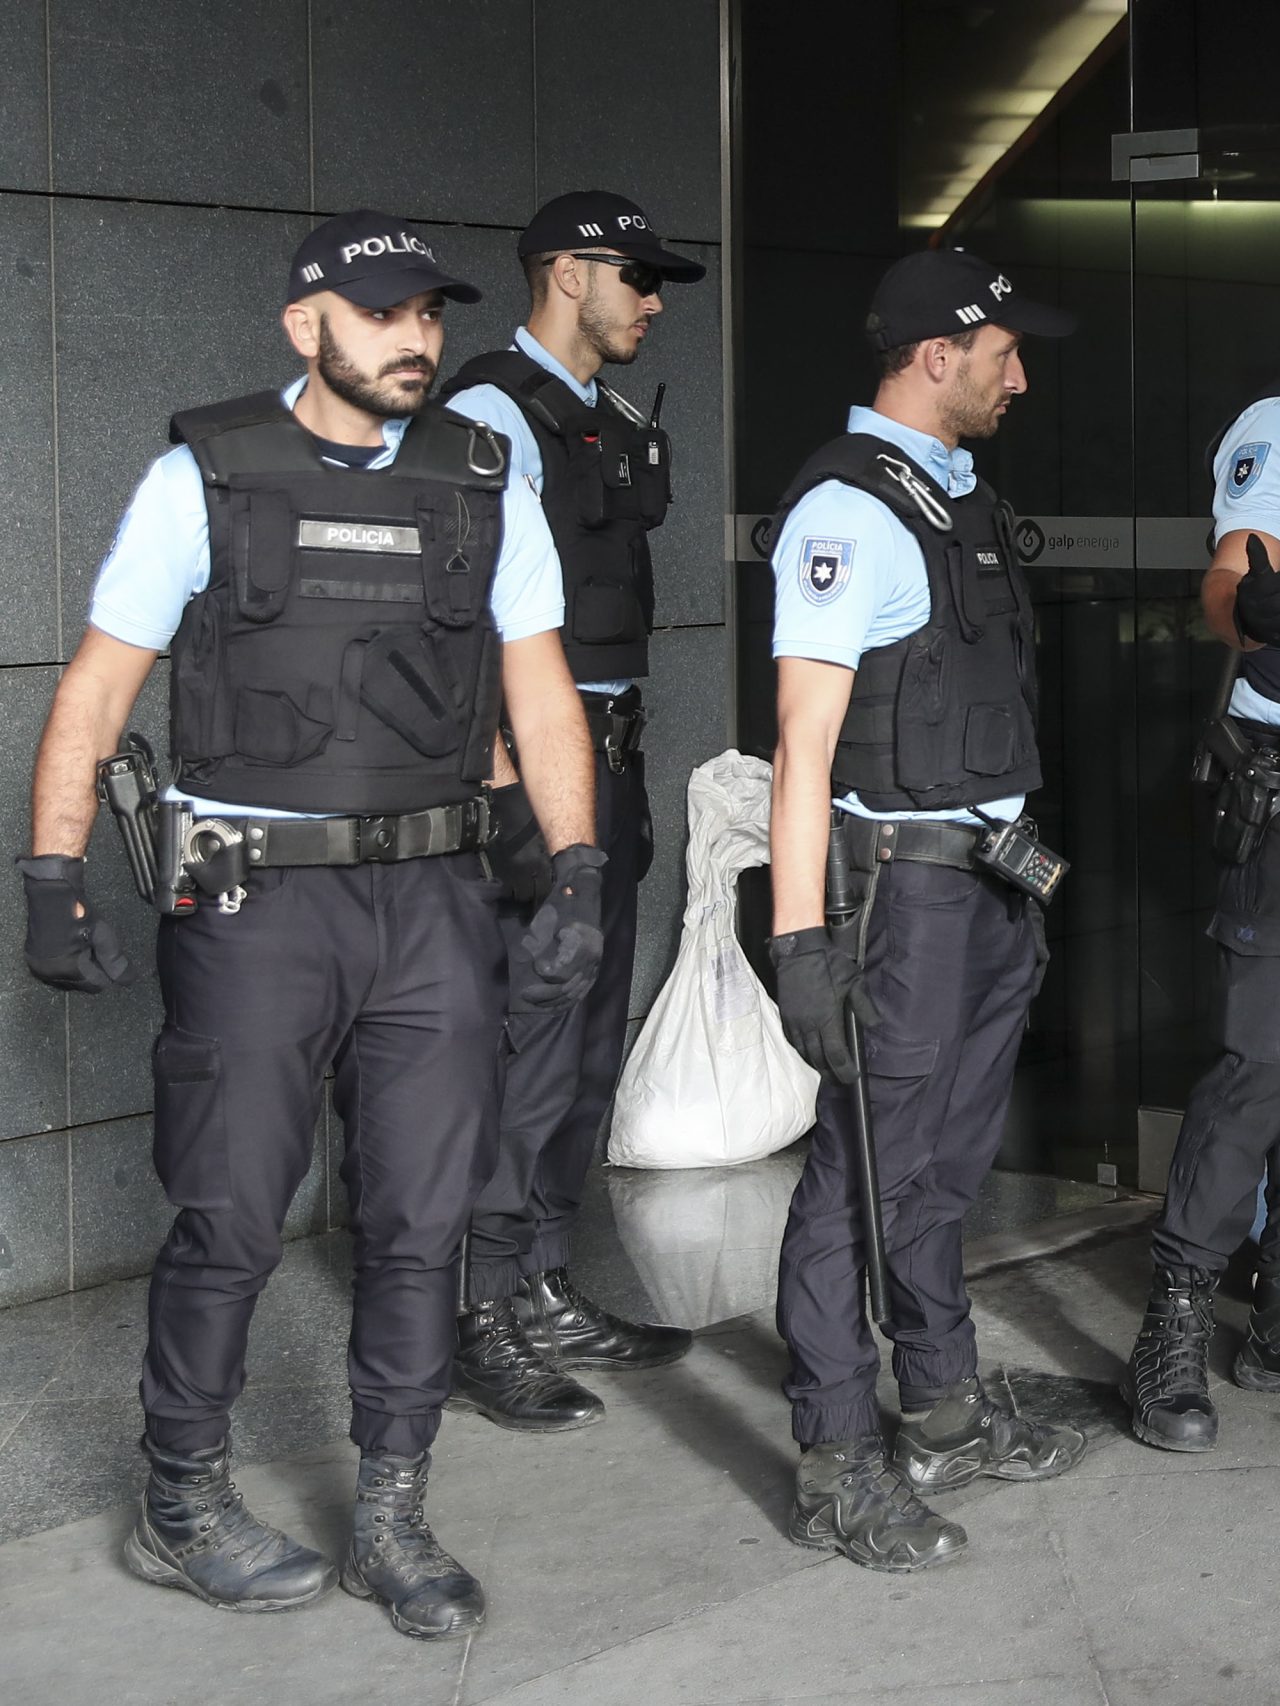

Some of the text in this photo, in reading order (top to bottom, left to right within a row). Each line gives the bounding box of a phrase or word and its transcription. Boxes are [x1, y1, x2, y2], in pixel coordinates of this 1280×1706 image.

[327, 527, 395, 546] POLICIA
[1048, 534, 1120, 552] galp energia
